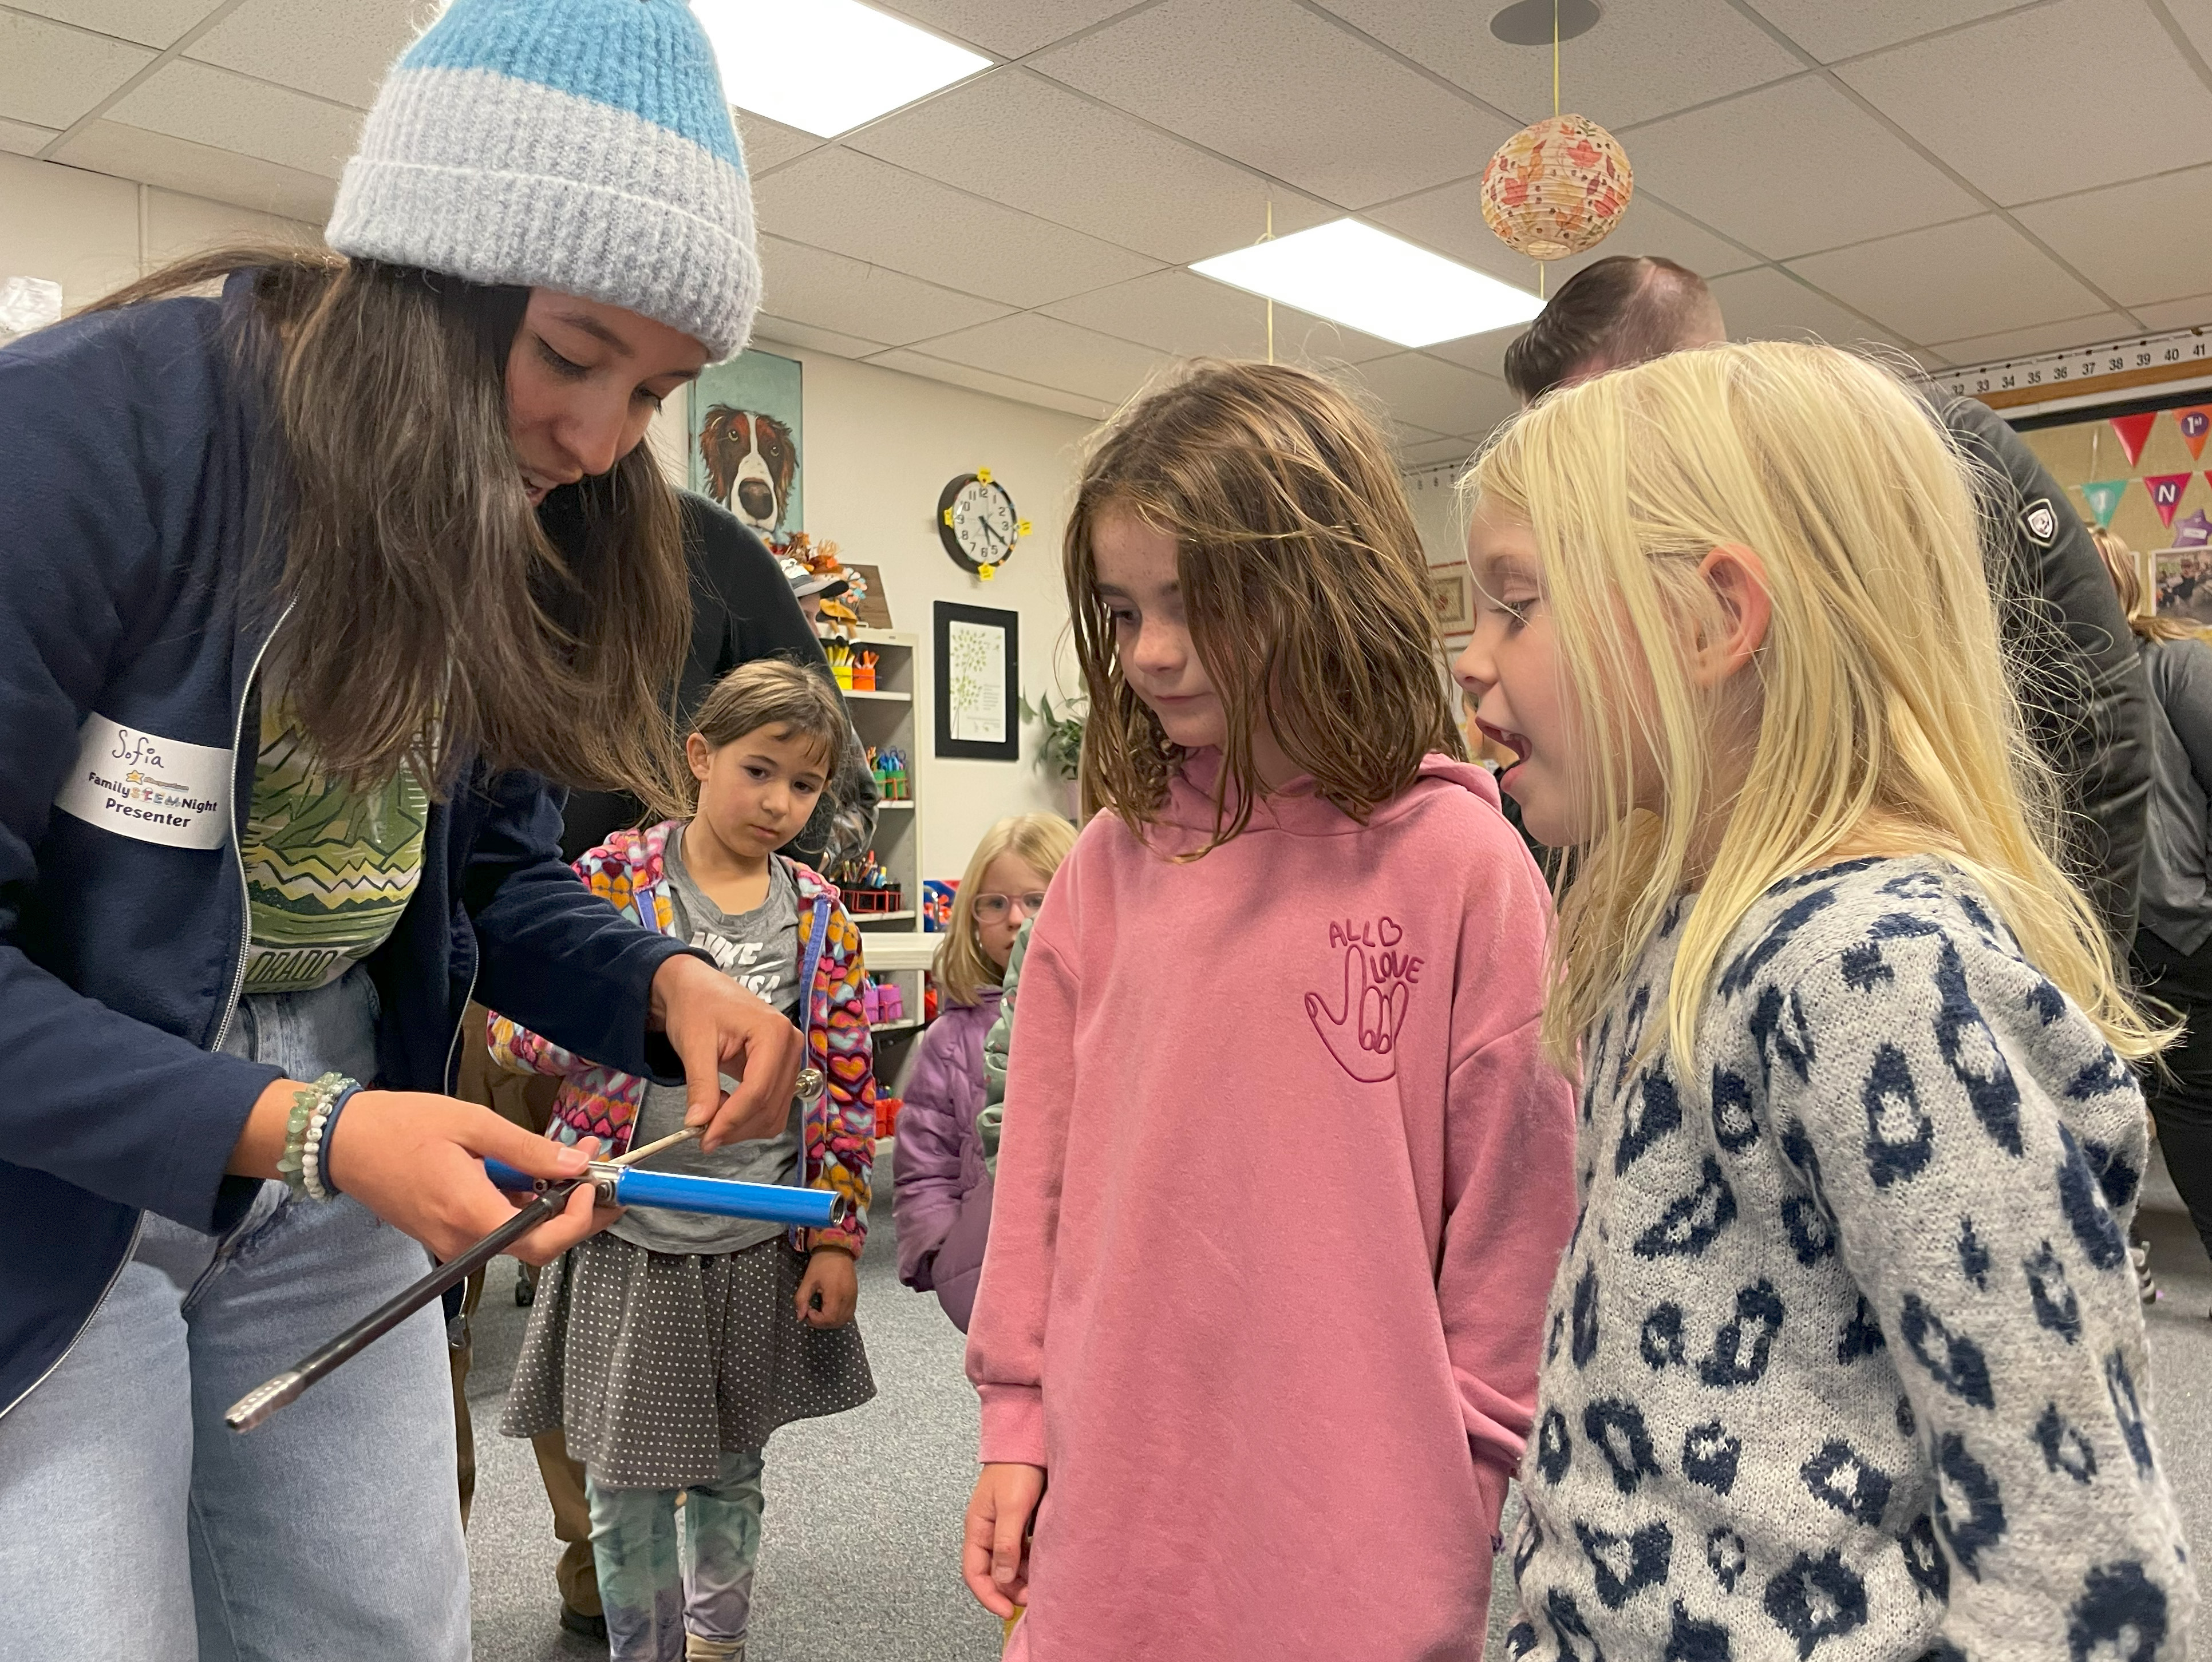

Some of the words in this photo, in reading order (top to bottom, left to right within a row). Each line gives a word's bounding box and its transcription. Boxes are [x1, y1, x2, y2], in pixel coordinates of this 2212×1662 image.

[1976, 379, 1990, 392] 33
[2001, 375, 2015, 389] 34
[2027, 371, 2041, 385] 35
[2053, 366, 2068, 380] 36
[2081, 362, 2096, 375] 37
[2109, 357, 2123, 371] 38
[2136, 353, 2151, 366] 39
[2164, 348, 2179, 361] 40
[2193, 343, 2206, 357] 41
[968, 490, 977, 501] 11
[978, 488, 989, 498] 12
[993, 494, 997, 504] 1
[2158, 484, 2176, 503] N
[998, 506, 1006, 517] 2
[1001, 521, 1009, 531] 3
[962, 529, 969, 541] 8
[969, 541, 977, 554] 7
[981, 547, 988, 558] 6
[990, 545, 998, 555] 5
[112, 729, 164, 769] Sofia
[105, 797, 191, 828] Presenter
[1329, 917, 1376, 949] ALL
[689, 931, 764, 968] NIKE
[1369, 949, 1425, 984] LOVE
